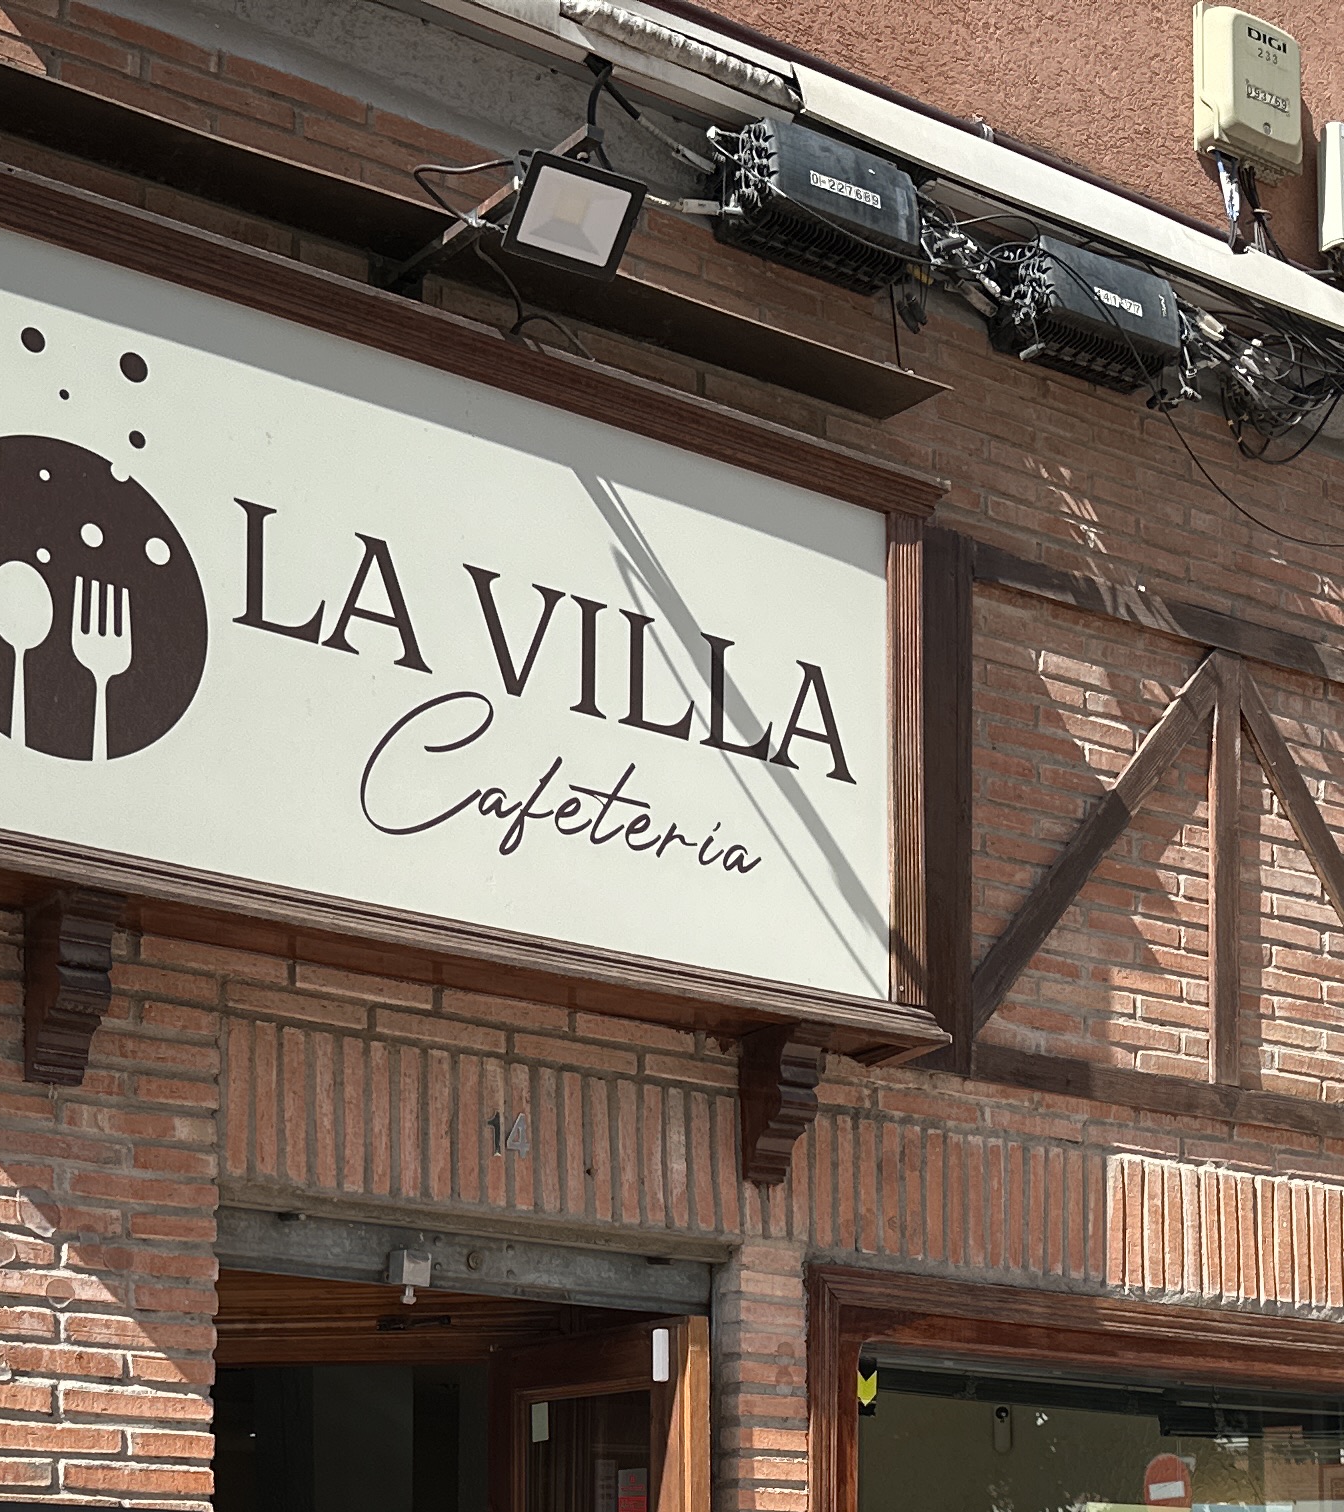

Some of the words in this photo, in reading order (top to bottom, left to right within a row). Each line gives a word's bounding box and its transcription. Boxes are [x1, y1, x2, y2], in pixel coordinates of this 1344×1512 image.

[1248, 26, 1287, 54] DIGI
[1258, 47, 1278, 65] 233
[232, 496, 433, 674] LA
[462, 562, 857, 785] VILLA
[487, 1110, 530, 1159] 14
